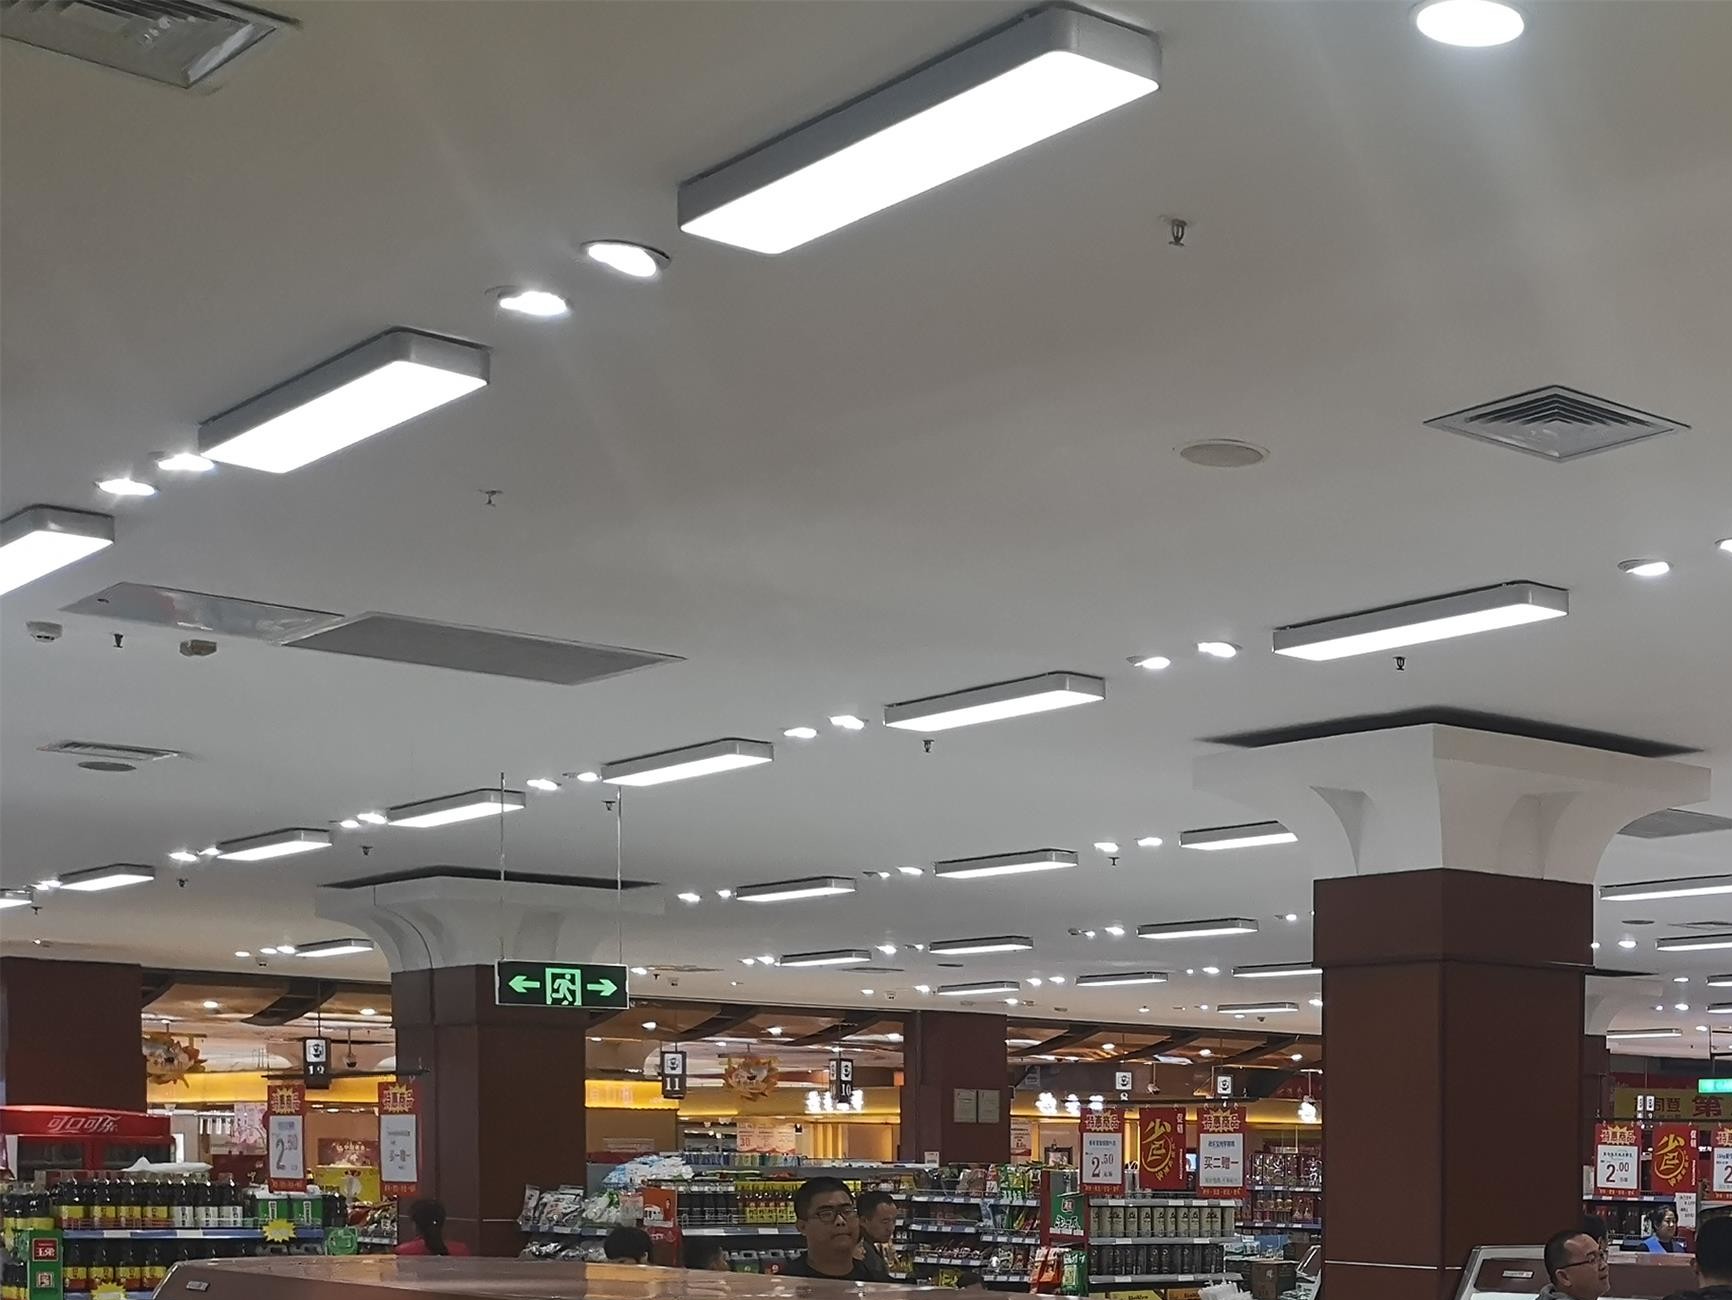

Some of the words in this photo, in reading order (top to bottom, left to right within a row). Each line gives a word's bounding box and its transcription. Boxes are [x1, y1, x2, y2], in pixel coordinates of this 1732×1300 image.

[665, 1077, 680, 1091] 11
[47, 1114, 122, 1133] 可口可乐
[1203, 1155, 1239, 1170] 买二赠一
[1605, 1162, 1630, 1183] 2.00
